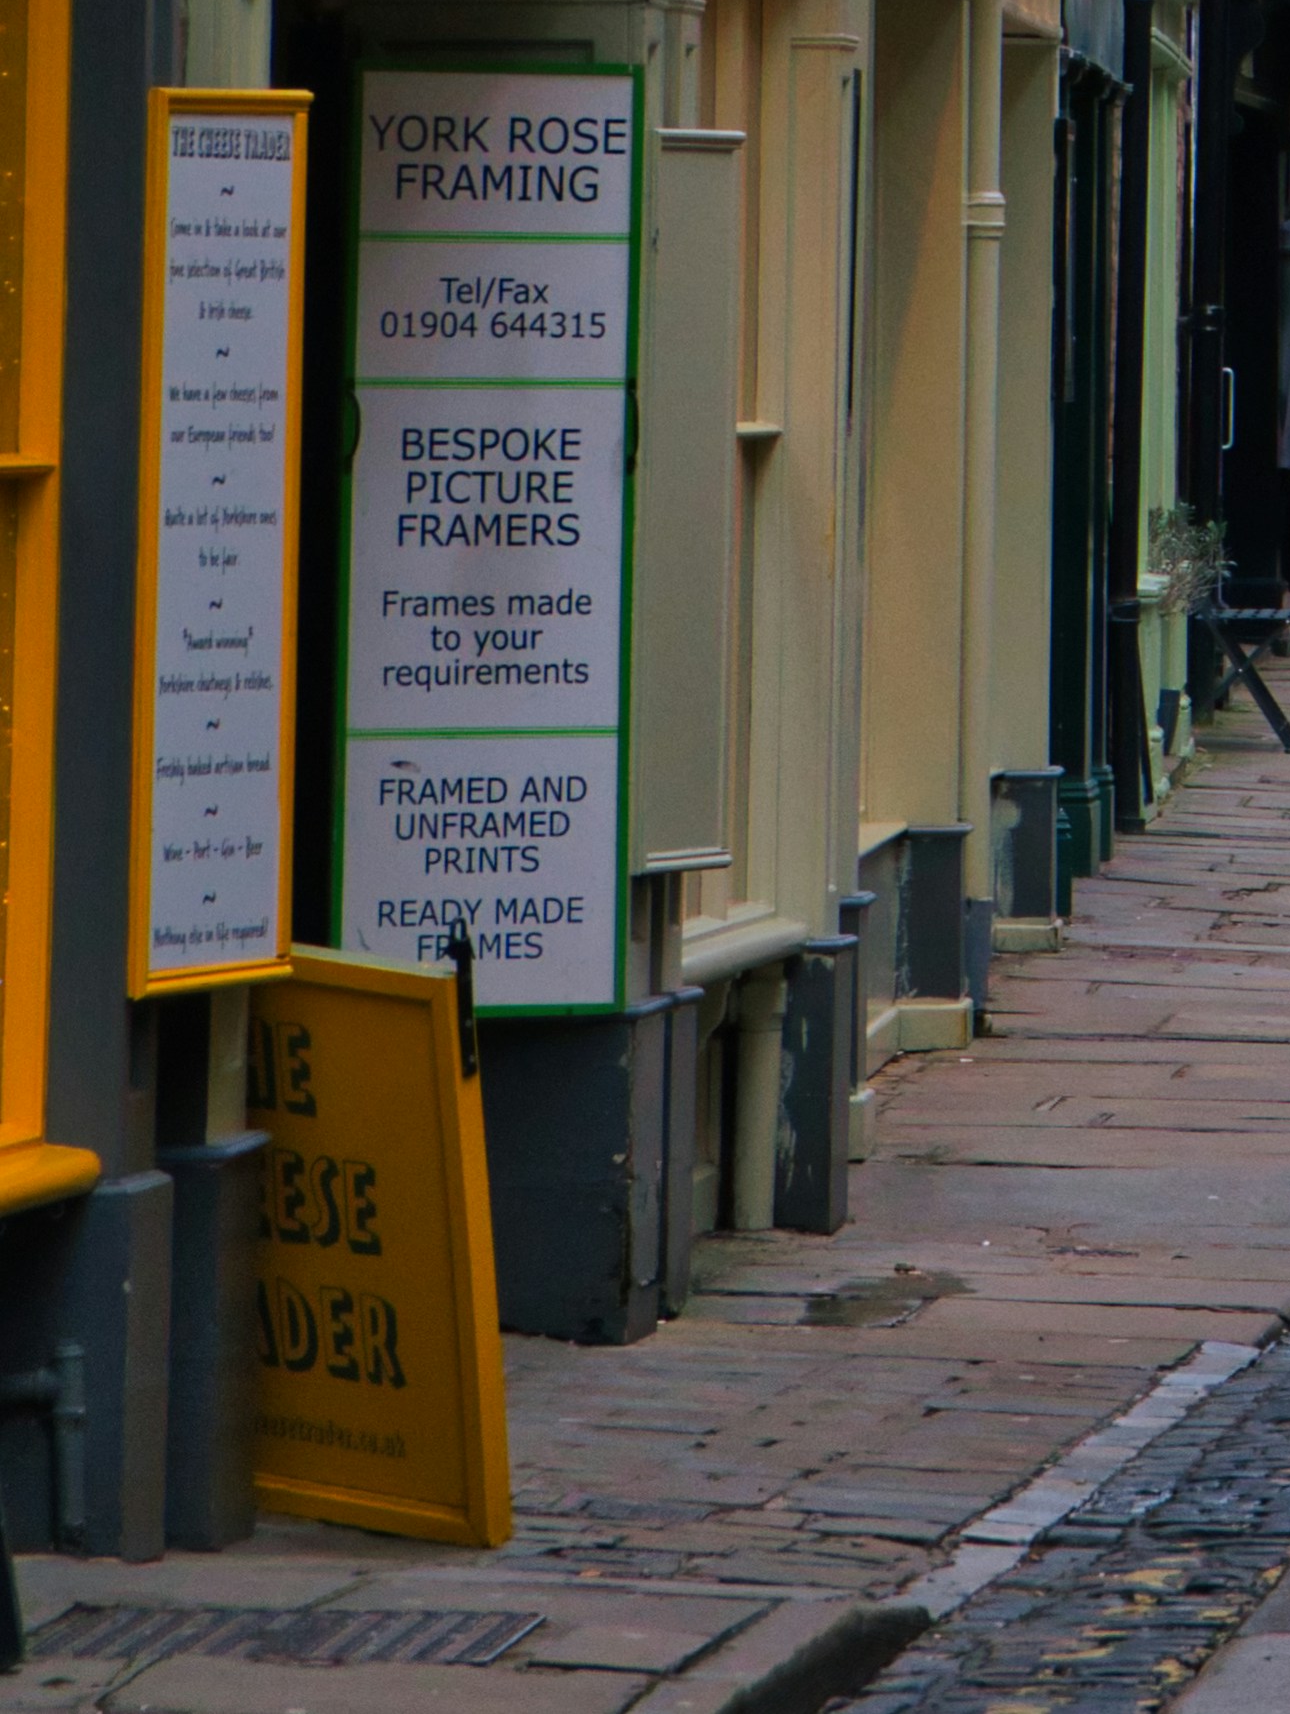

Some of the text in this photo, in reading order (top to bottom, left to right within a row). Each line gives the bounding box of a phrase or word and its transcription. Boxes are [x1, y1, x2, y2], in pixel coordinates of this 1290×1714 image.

[171, 125, 291, 162] THE CHEESE TRADER
[369, 115, 628, 155] YORK ROSE
[396, 163, 600, 203] FRAMING
[439, 277, 549, 308] Tel/Fax
[380, 310, 607, 339] 01904 644315
[187, 425, 226, 452] European
[401, 427, 582, 461] BESPOKE
[406, 471, 574, 504] PICTURE
[397, 513, 580, 548] FRAMERS
[382, 588, 592, 617] Frames made
[430, 626, 544, 658] to your
[382, 658, 590, 693] requirements
[379, 775, 588, 806] FRAMED AND
[395, 810, 571, 841] UNFRAMED
[424, 846, 540, 874] PRINTS
[377, 896, 585, 927] READY MADE
[417, 932, 544, 962] FRMES
